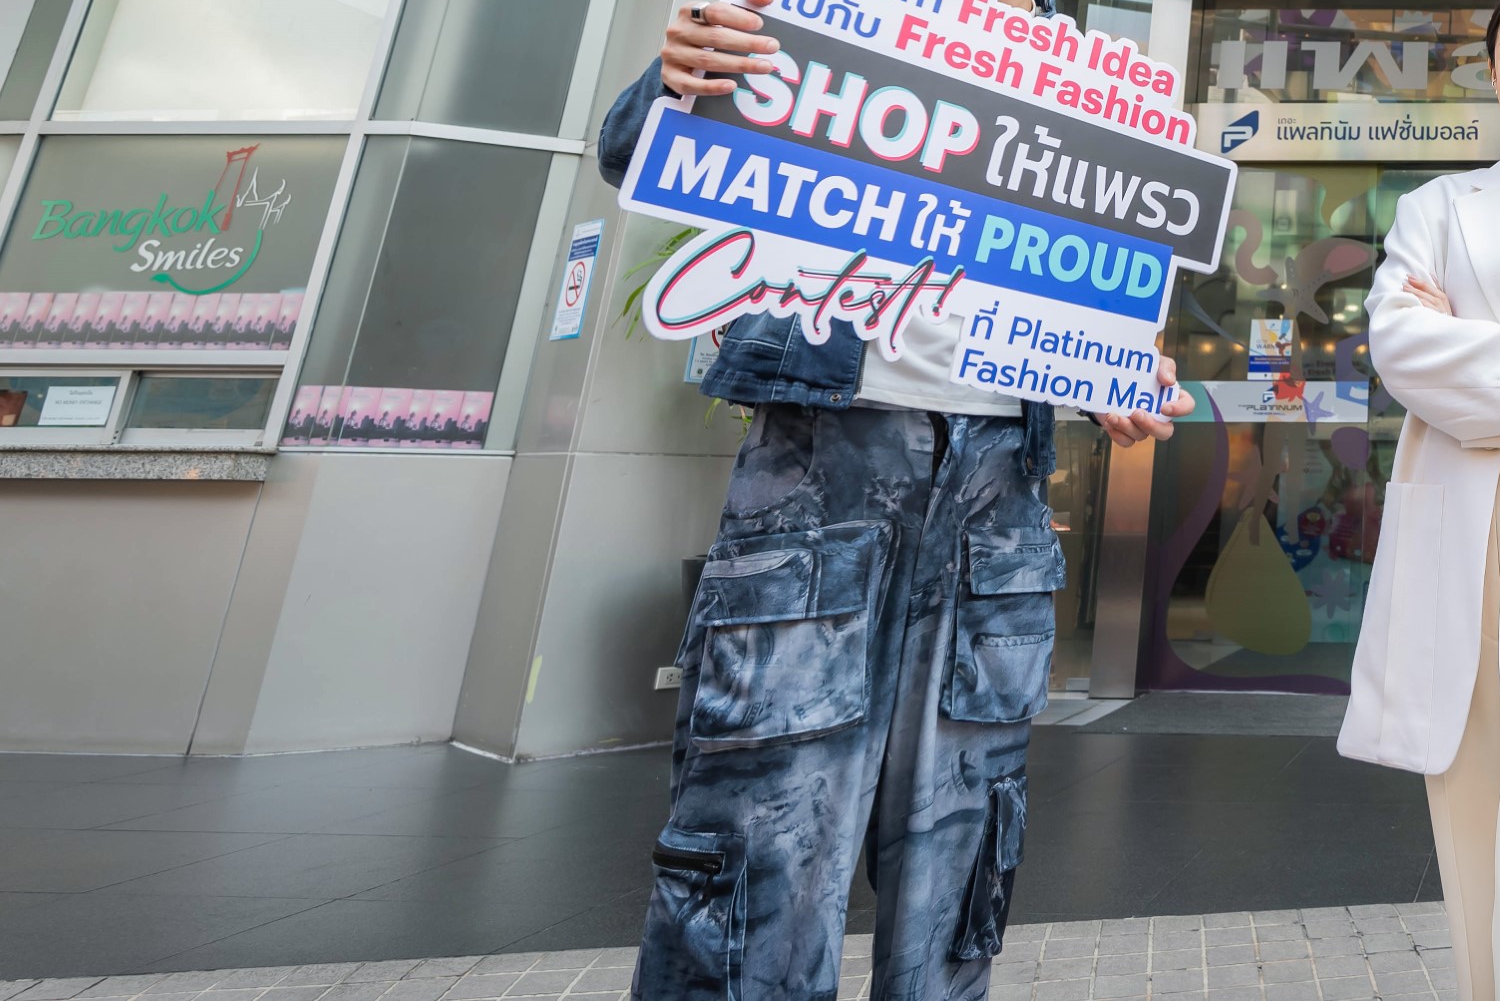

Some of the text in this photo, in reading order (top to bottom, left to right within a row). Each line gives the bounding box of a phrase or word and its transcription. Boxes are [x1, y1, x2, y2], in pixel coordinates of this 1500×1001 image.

[895, 13, 1025, 89] Fresh
[1033, 63, 1192, 145] Fashion
[1087, 37, 1176, 96] Idea
[732, 50, 1201, 237] SHOP ให้แพรว
[1276, 114, 1480, 141] แพลทินัม แฟชั่นมอลล์
[31, 189, 226, 253] Bangkok
[656, 135, 1164, 299] MATCH ให้ PROUD
[129, 237, 245, 273] Smiles
[969, 301, 1154, 375] ที่ Platinum
[958, 349, 1174, 415] Fashion Mall
